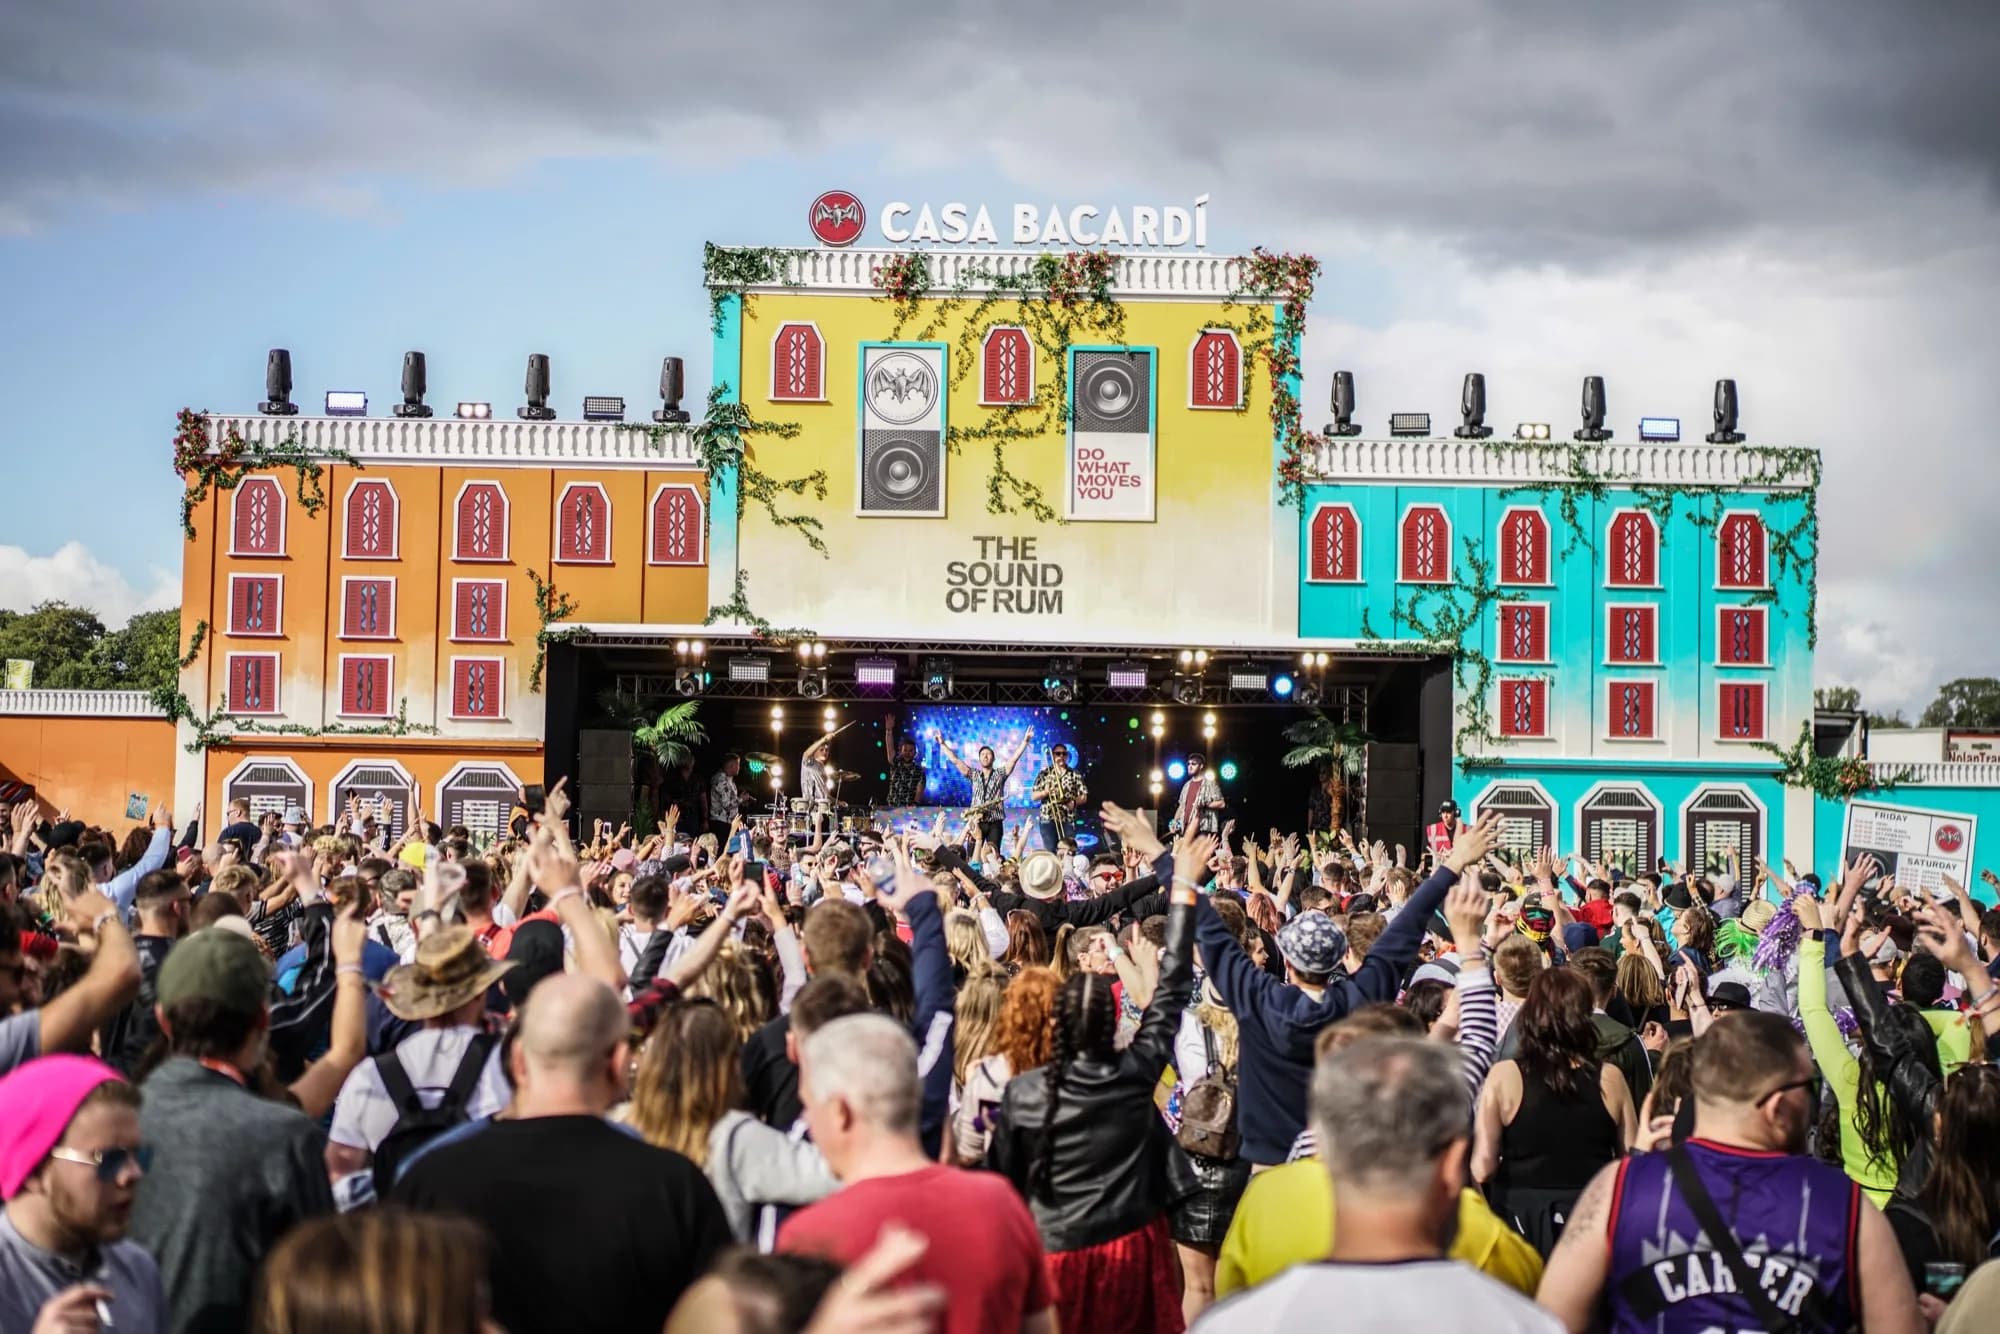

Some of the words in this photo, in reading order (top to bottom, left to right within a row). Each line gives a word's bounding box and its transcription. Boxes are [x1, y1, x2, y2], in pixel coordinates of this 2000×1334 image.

[881, 201, 998, 243] CASA
[1014, 192, 1210, 247] BACARDÍ
[1077, 447, 1105, 461] DO
[1077, 461, 1131, 474] WHAT
[1077, 474, 1141, 488] MOVES
[1077, 487, 1114, 500] YOU
[972, 535, 1037, 561] THE
[946, 561, 1063, 588] SOUND
[945, 588, 986, 613] OF
[993, 589, 1063, 615] RUM
[1948, 751, 2000, 763] NolanTra
[1874, 811, 1908, 823] FRIDAY
[1907, 857, 1957, 870] SATURDAY
[1653, 1250, 1813, 1316] CARER
